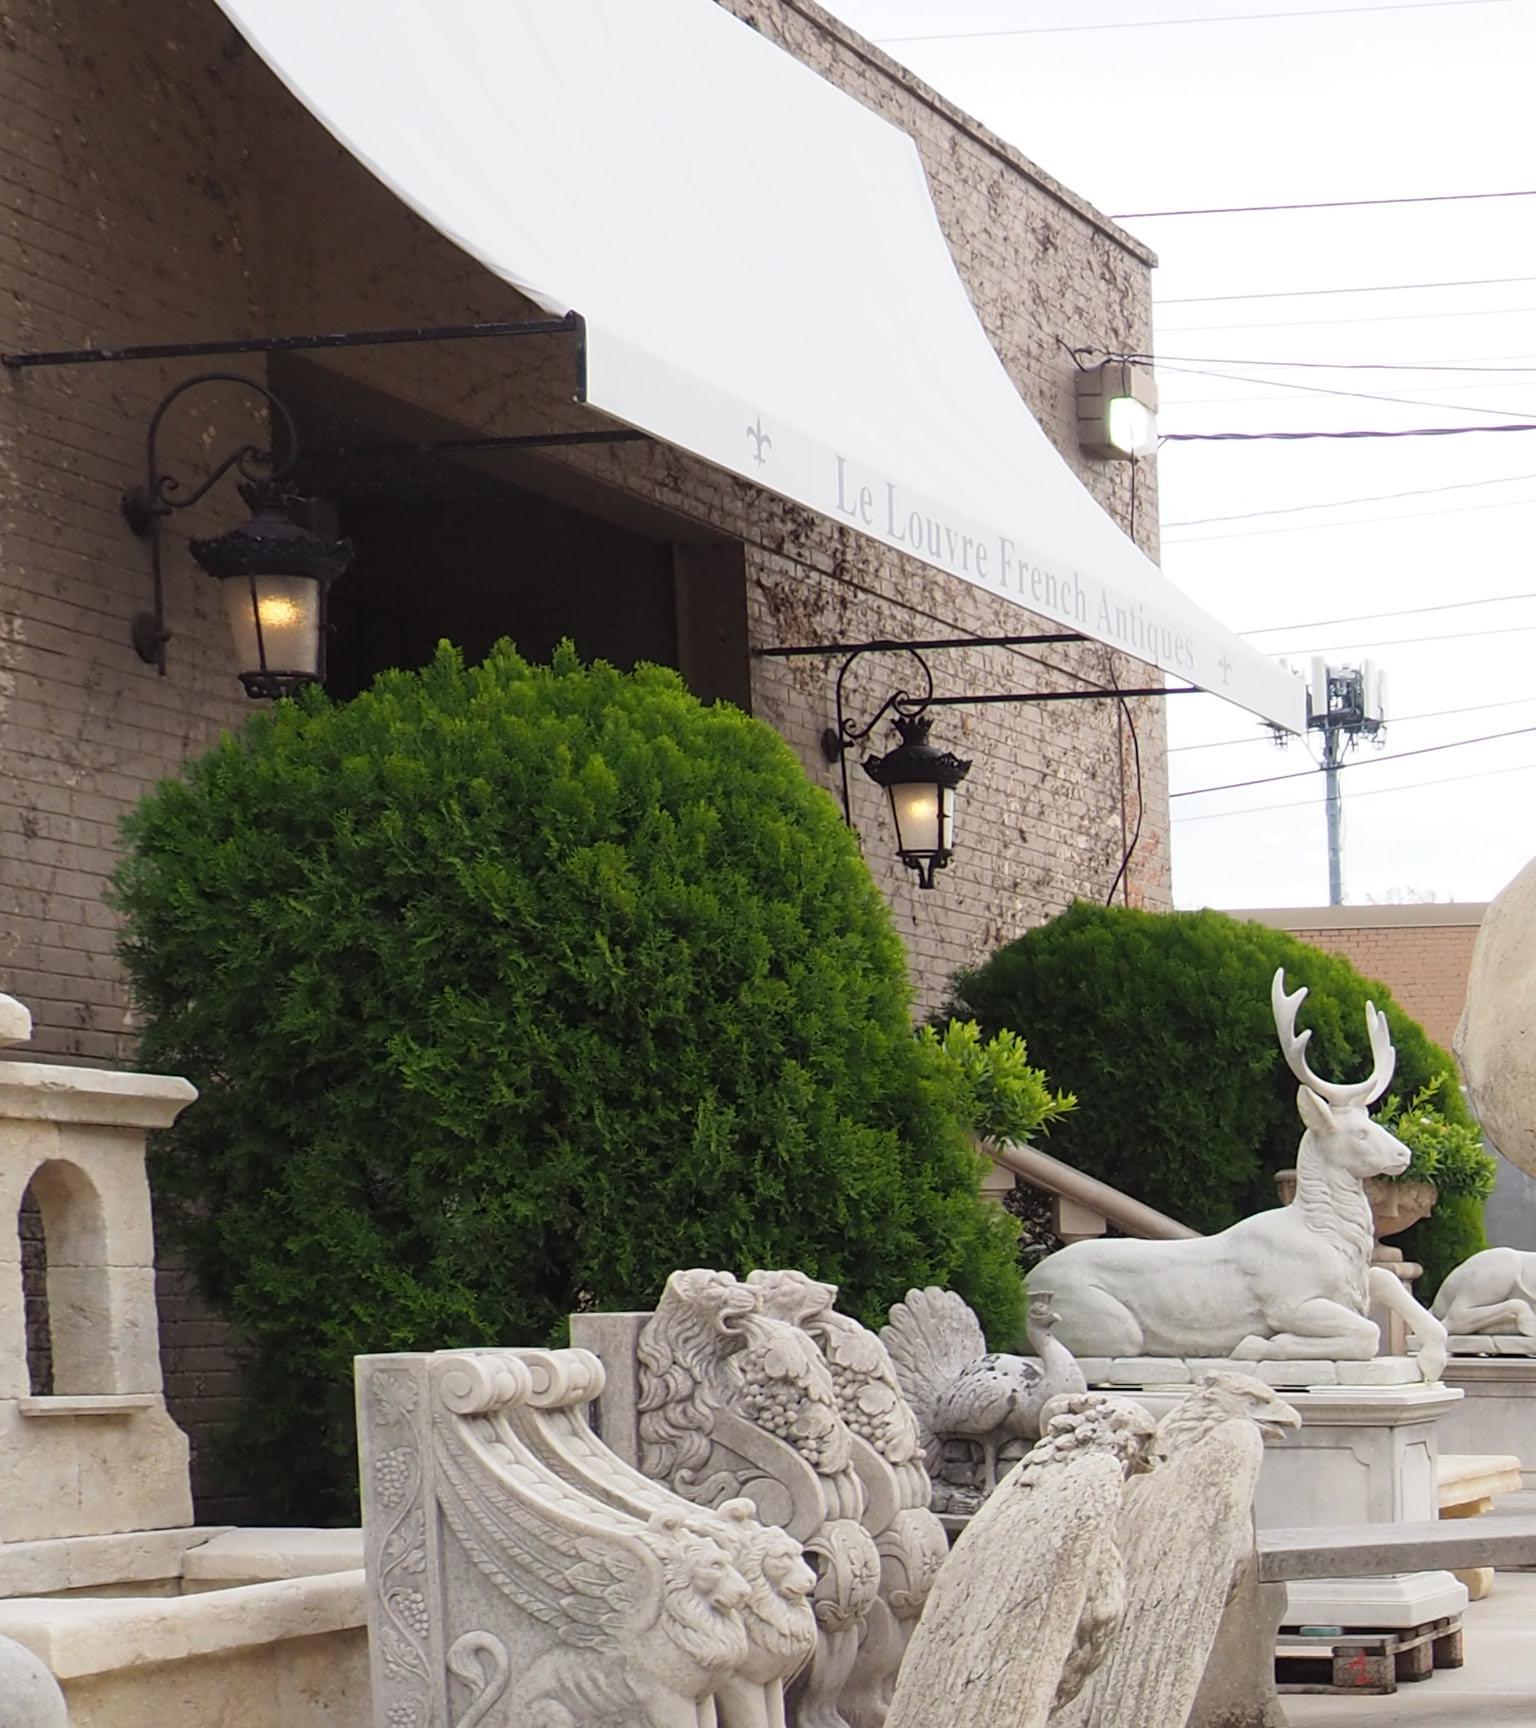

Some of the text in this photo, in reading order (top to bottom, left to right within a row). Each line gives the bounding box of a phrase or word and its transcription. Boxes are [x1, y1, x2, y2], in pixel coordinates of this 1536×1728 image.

[835, 454, 1195, 670] Le Louvre French Antiques
